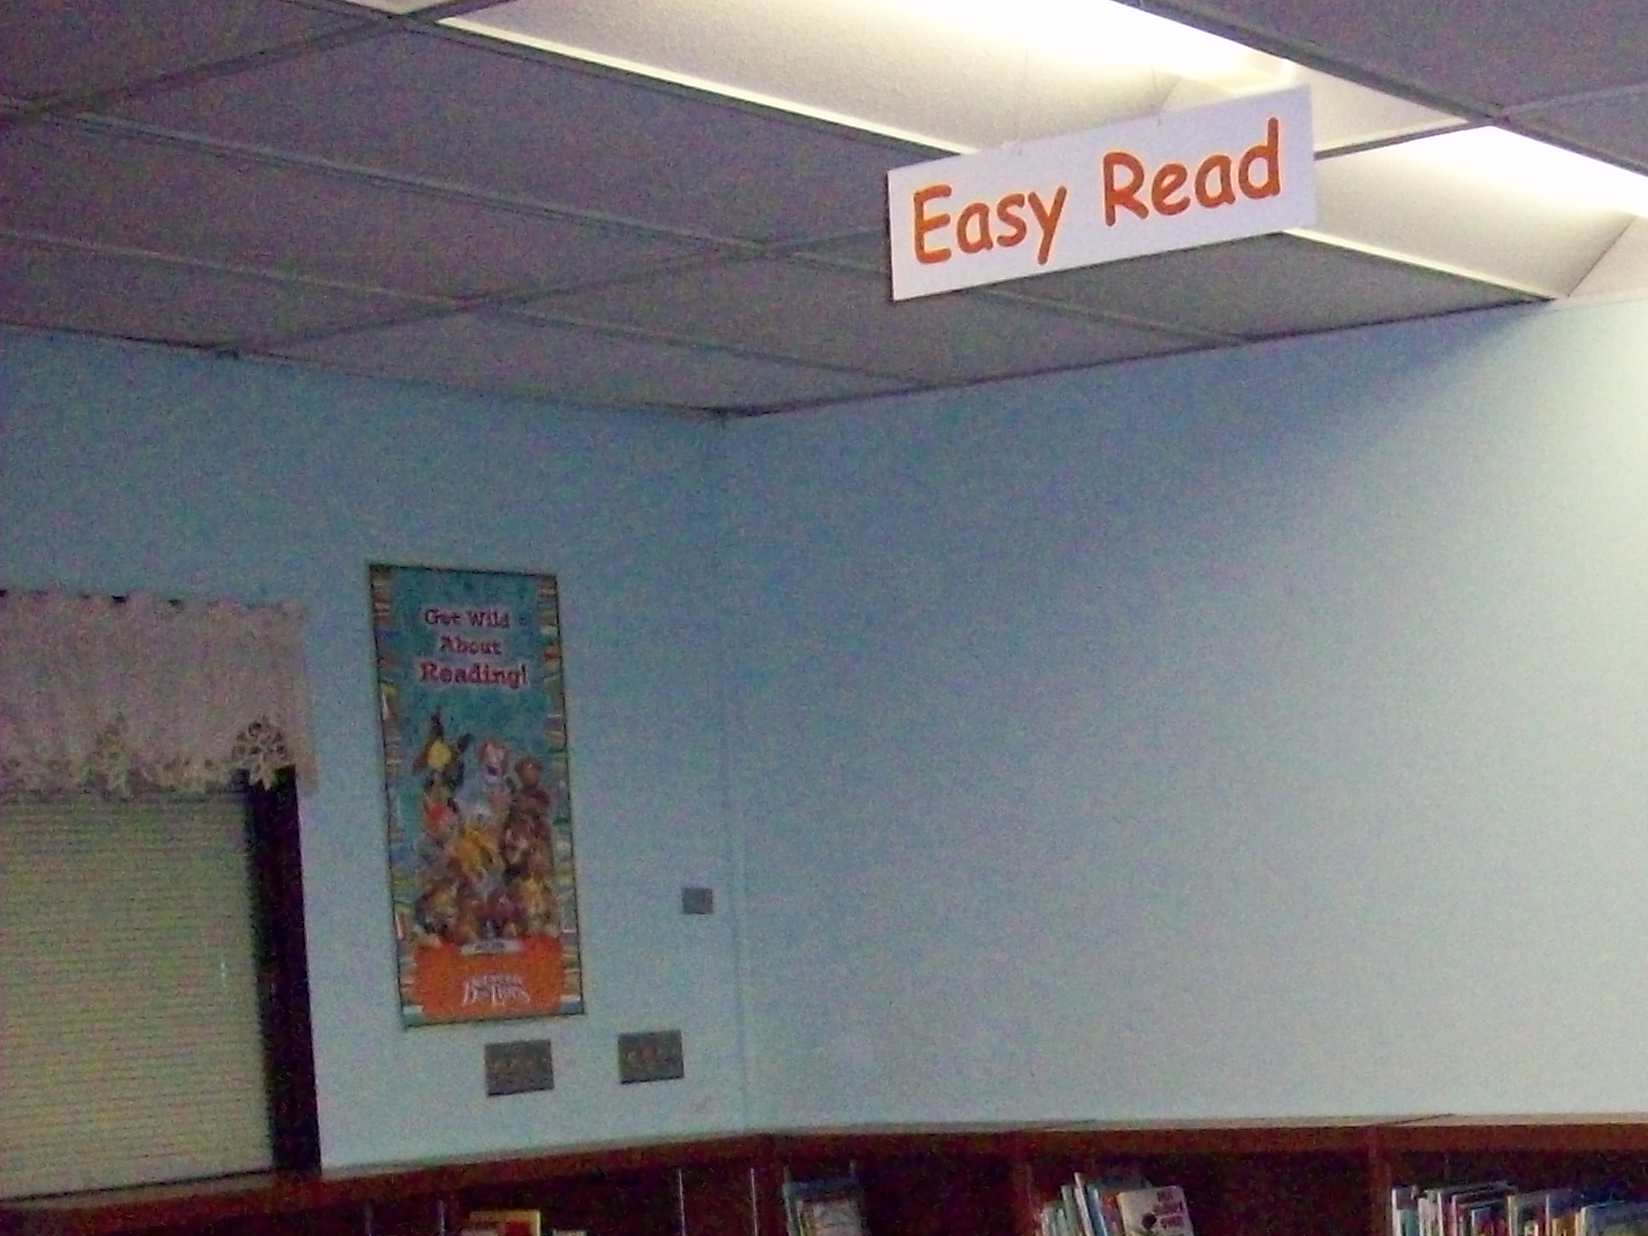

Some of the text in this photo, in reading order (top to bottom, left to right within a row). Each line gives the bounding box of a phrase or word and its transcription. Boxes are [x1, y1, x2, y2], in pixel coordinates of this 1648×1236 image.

[912, 116, 1281, 265] Easy Read
[424, 608, 511, 630] Get Wild
[440, 635, 503, 655] About
[419, 662, 527, 690] Reading!
